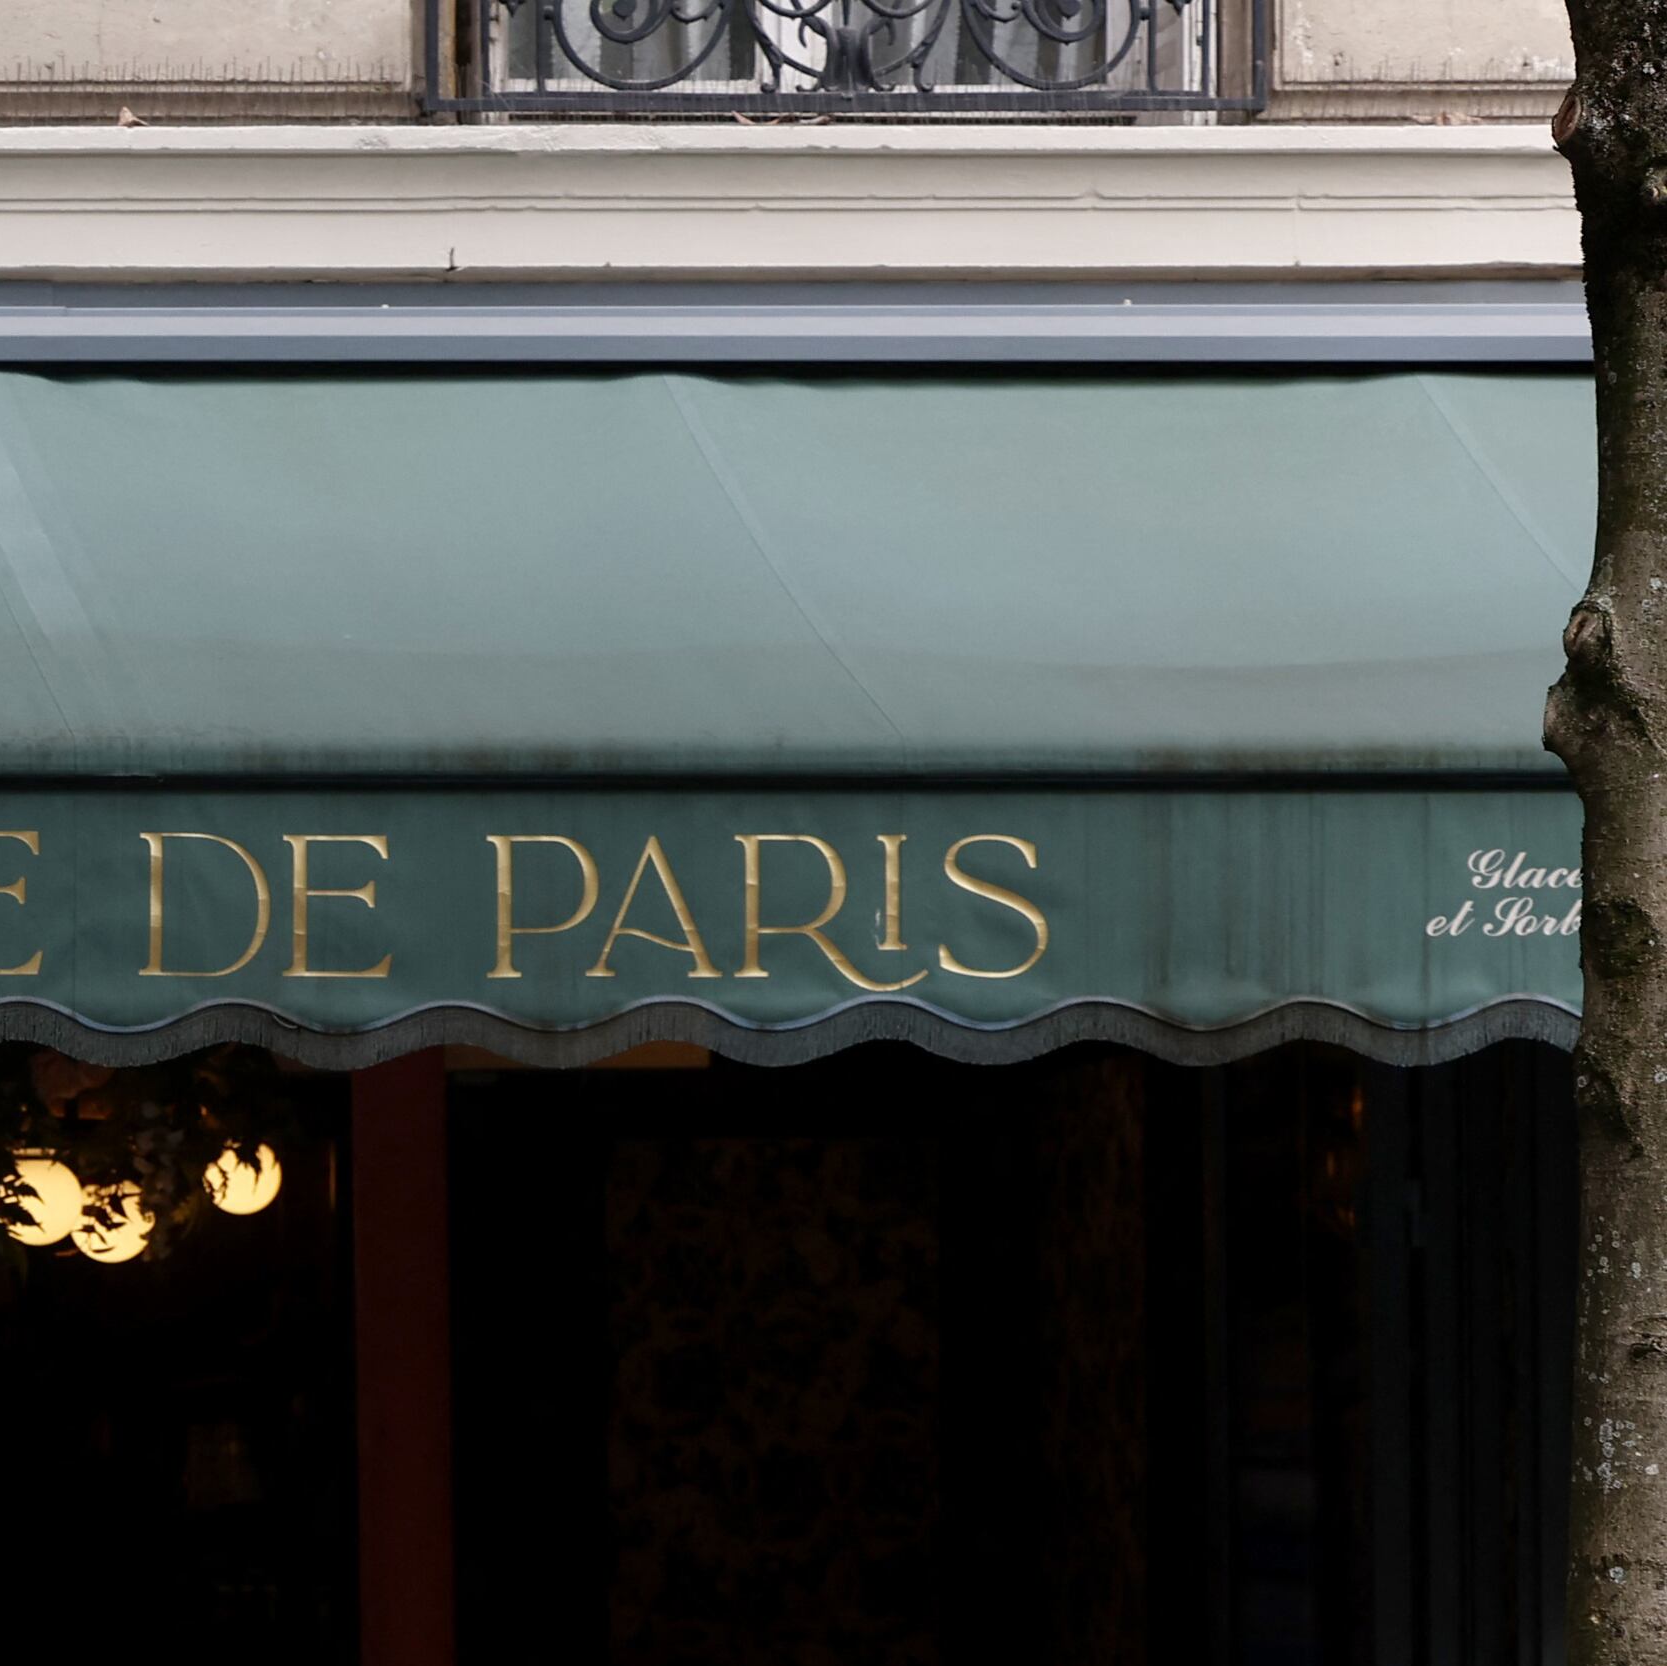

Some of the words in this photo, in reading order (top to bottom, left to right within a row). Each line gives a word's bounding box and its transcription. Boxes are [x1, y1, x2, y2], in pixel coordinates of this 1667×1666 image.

[138, 832, 392, 978] DE
[485, 833, 1048, 992] PARIS
[1425, 900, 1475, 936] et
